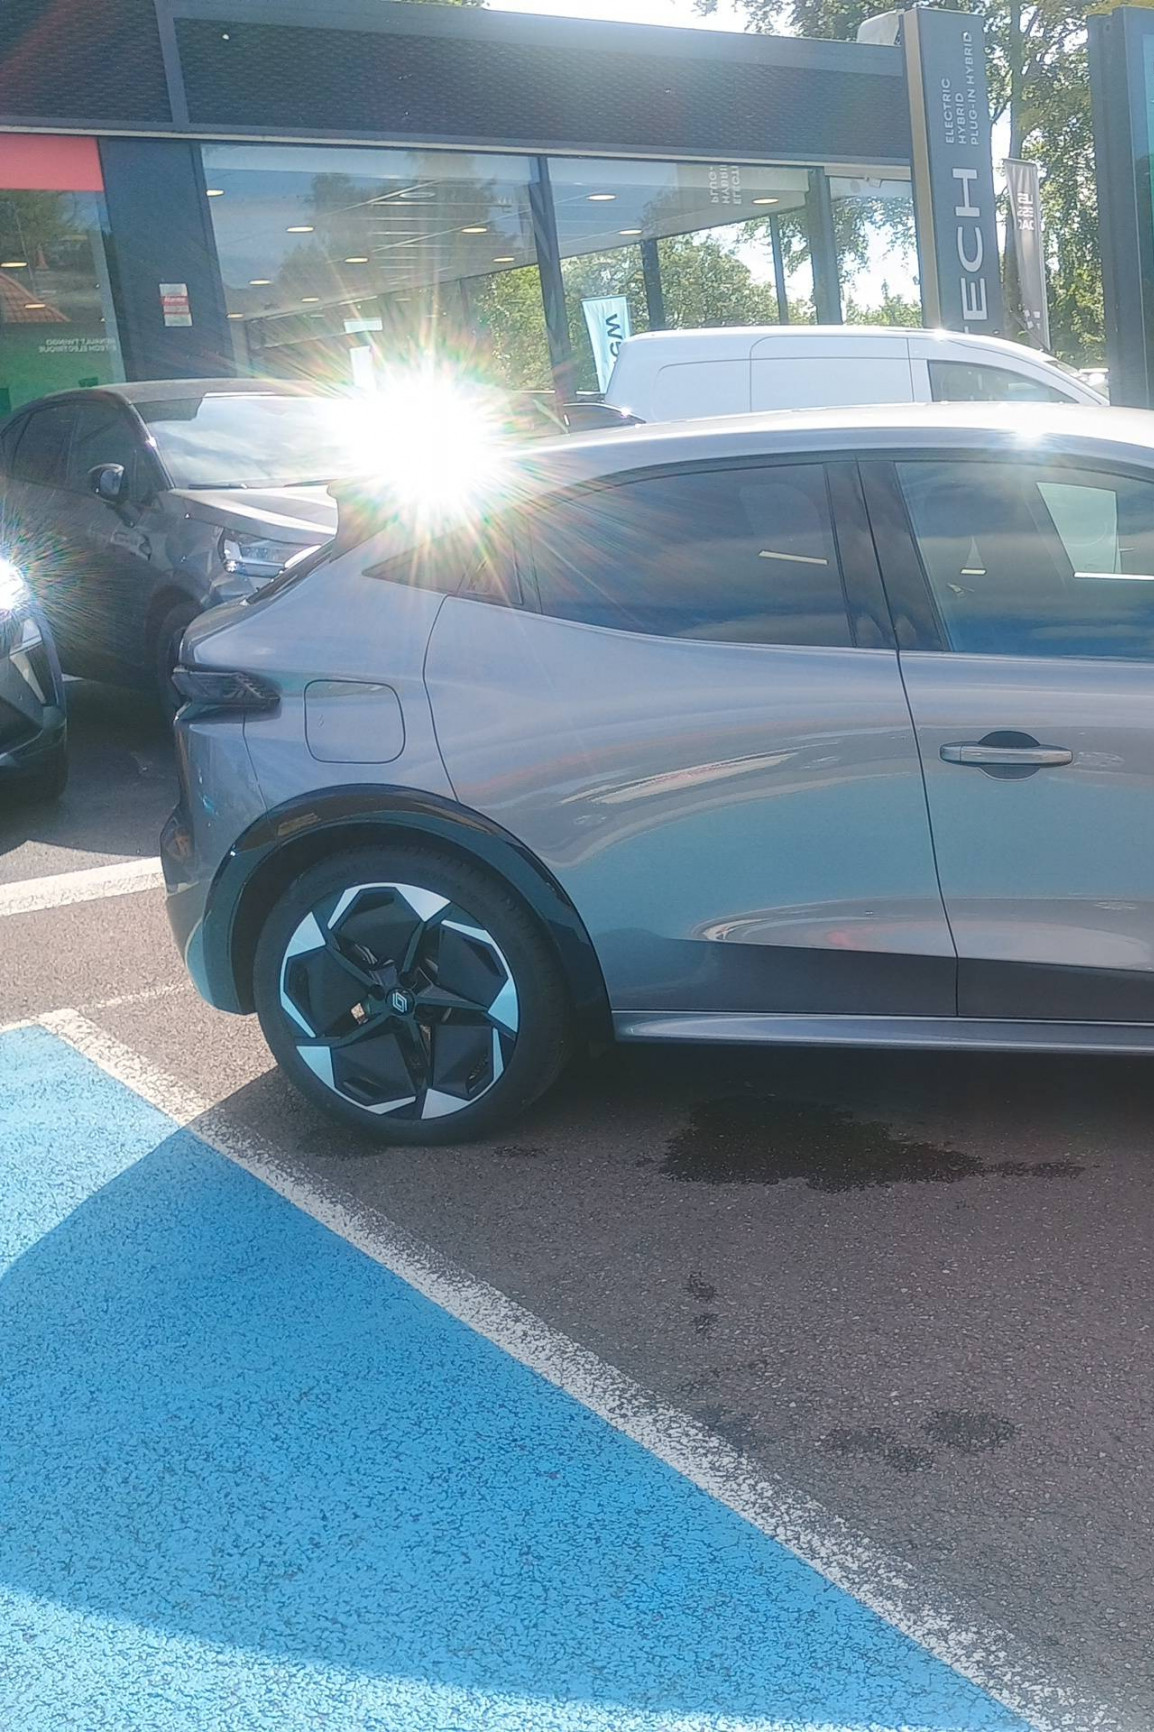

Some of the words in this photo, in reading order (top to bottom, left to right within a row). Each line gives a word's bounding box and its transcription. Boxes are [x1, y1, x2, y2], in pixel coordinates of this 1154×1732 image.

[963, 31, 975, 84] HYBRID
[941, 78, 954, 143] ELECTRIC
[955, 92, 966, 144] HYBRID
[967, 89, 978, 145] PLUG-IN
[952, 168, 988, 333] ECH
